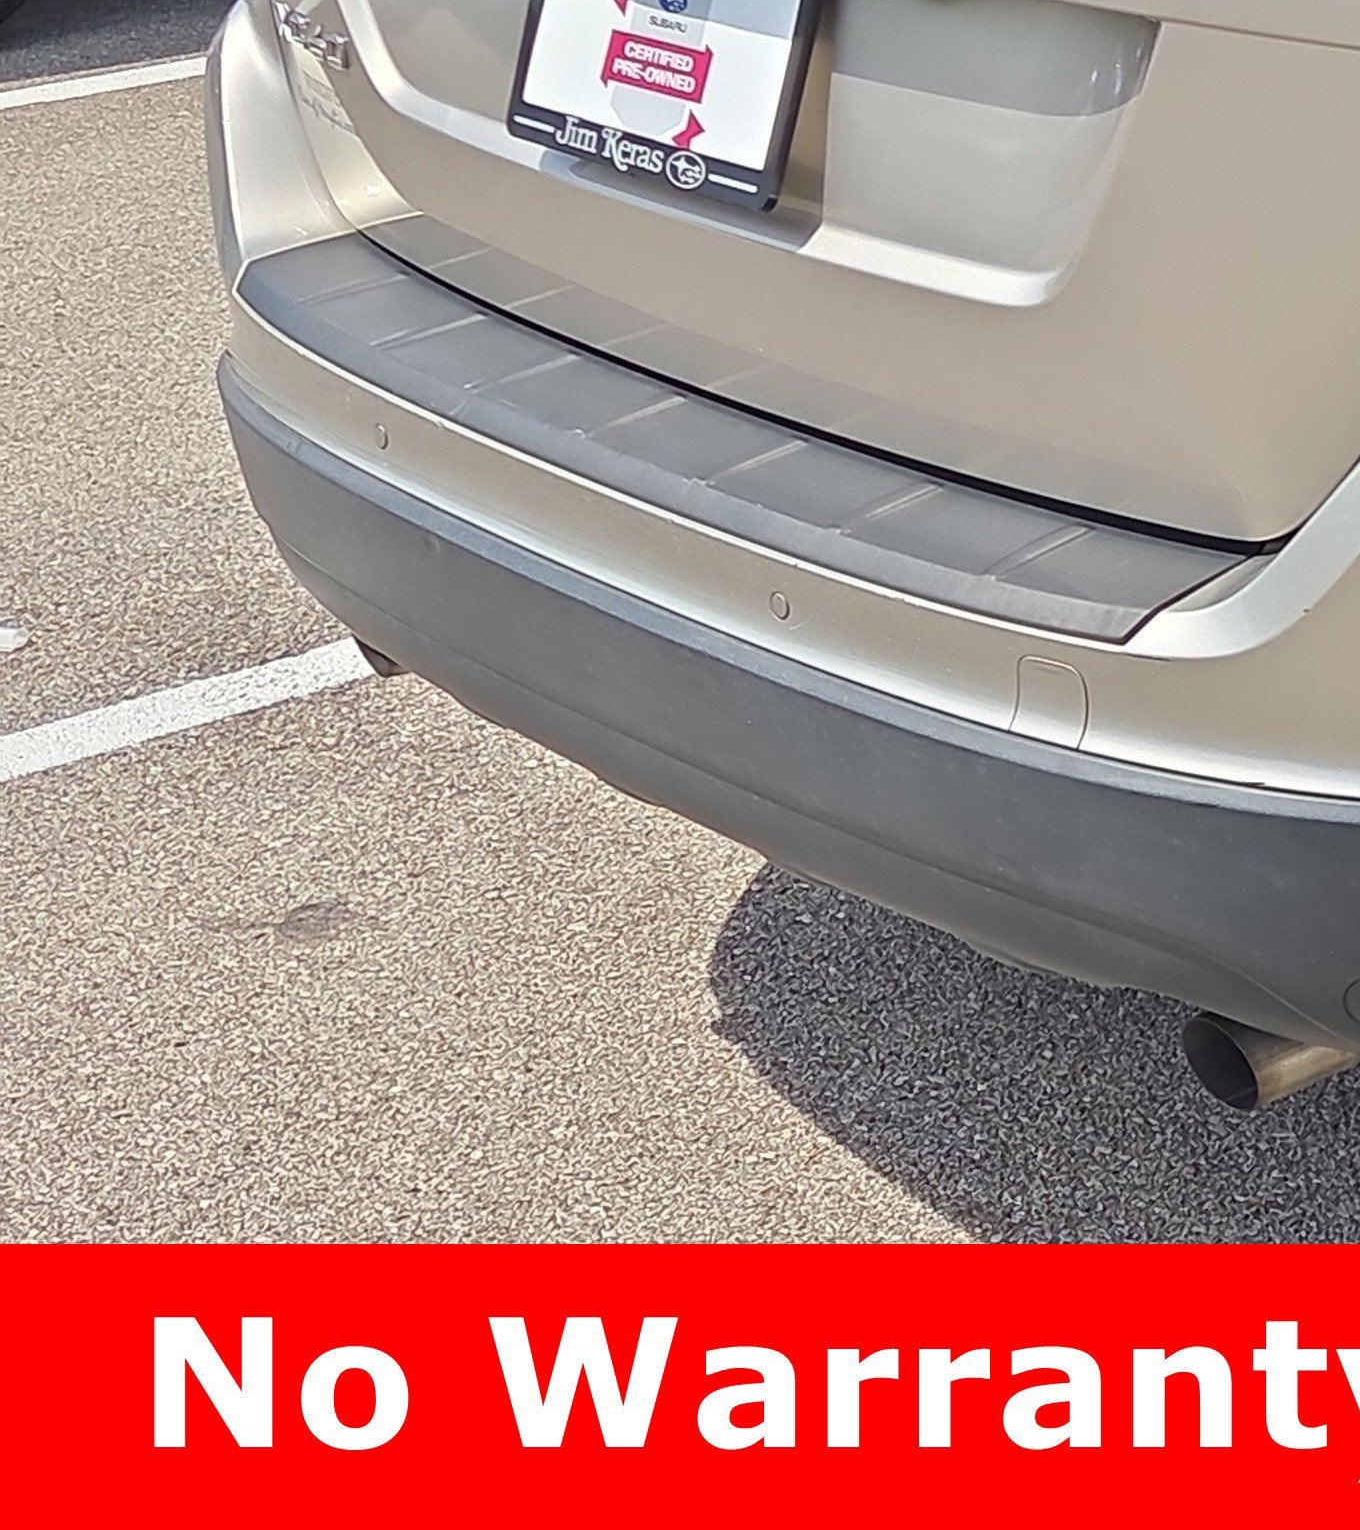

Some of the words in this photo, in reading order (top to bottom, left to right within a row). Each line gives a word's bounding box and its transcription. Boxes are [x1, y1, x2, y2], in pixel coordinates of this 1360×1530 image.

[648, 15, 687, 33] SUBARU
[624, 41, 694, 72] CERTIFIED
[612, 58, 695, 94] PRE-OWNED
[553, 116, 597, 154] Jim
[600, 128, 665, 173] Keras
